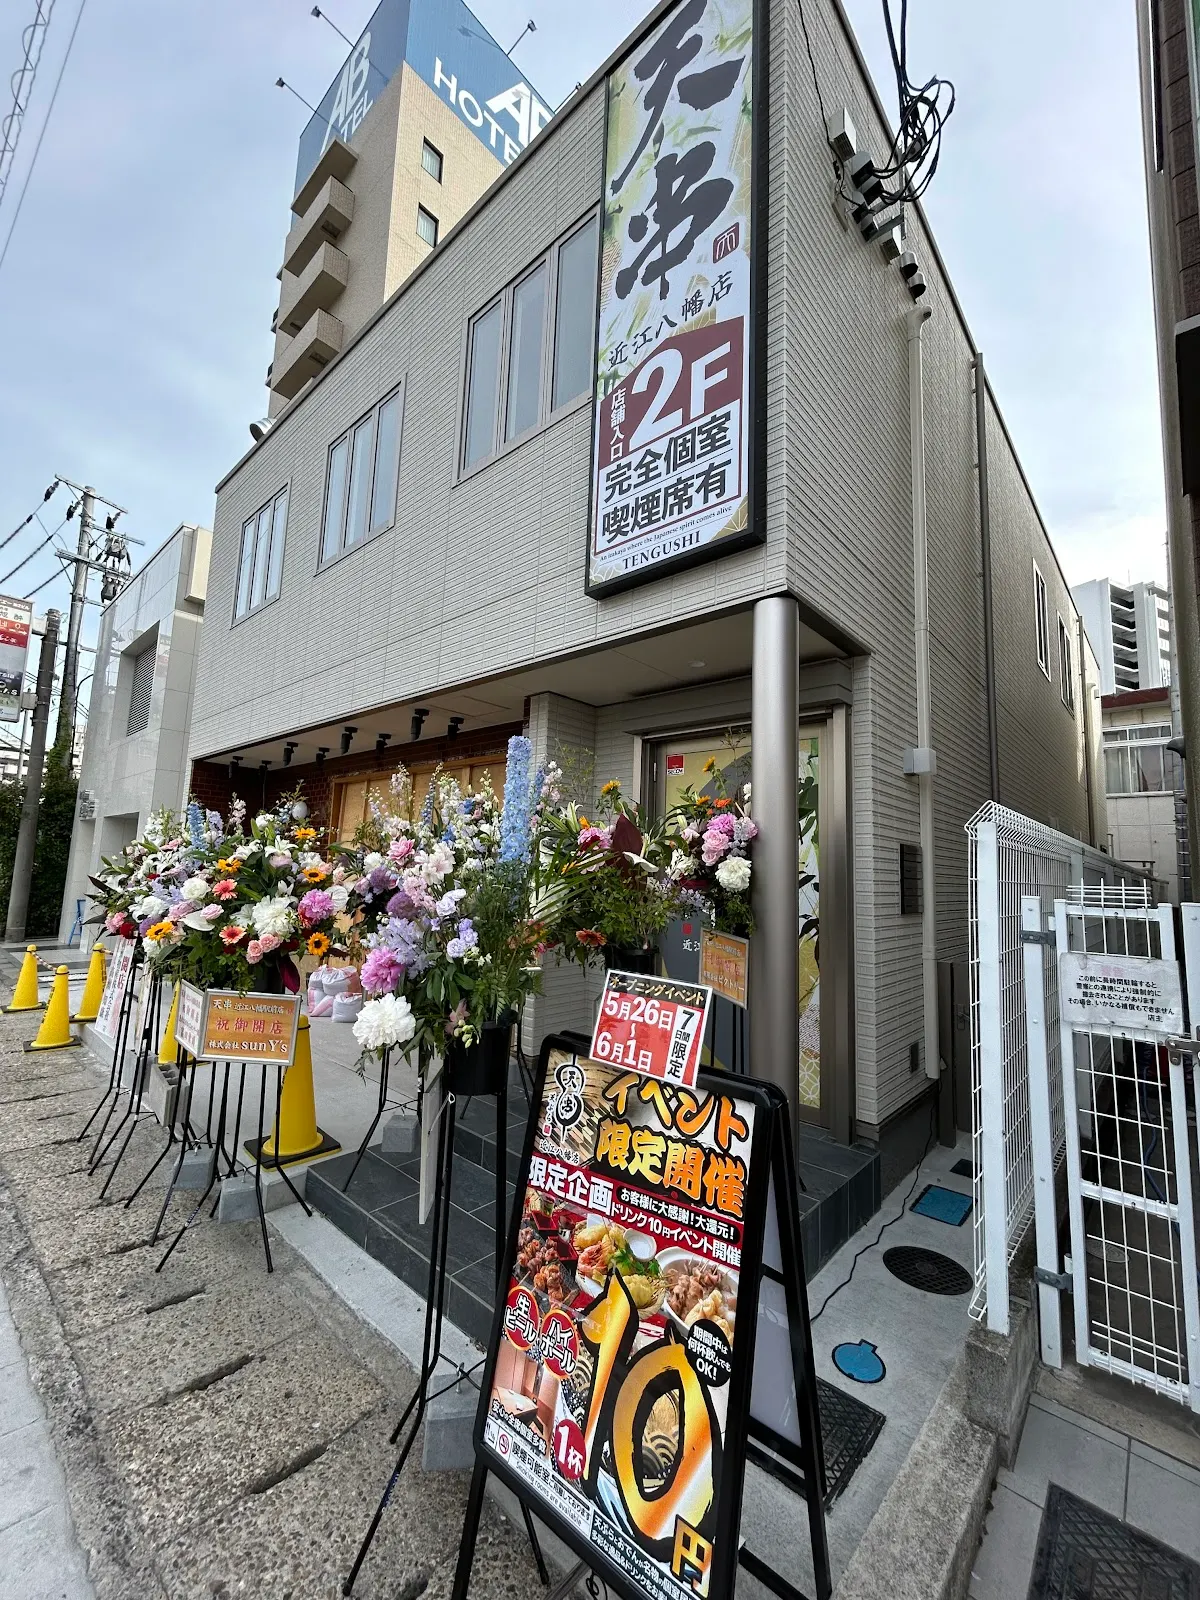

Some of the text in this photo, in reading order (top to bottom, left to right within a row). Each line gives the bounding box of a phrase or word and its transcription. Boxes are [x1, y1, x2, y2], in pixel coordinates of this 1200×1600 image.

[341, 90, 374, 144] TEL
[433, 56, 521, 166] HOTE
[608, 270, 734, 371] 近江八幡店
[628, 341, 732, 452] 2F
[609, 387, 627, 462] 店舗入口
[604, 410, 732, 503] 完全個室
[601, 459, 733, 544] 喫煙席有
[622, 530, 701, 570] TENGUSHI
[627, 540, 643, 551] where
[644, 537, 653, 545] the
[654, 527, 679, 541] Japanese
[679, 520, 696, 531] spirit
[696, 512, 716, 524] comes
[716, 505, 733, 517] alive
[213, 999, 232, 1010] 天串
[604, 992, 674, 1031] 5月26日
[609, 976, 704, 1006] オープニングイベント
[216, 1017, 284, 1035] 祝御開店
[1147, 1014, 1163, 1022] 店主
[208, 1040, 240, 1050] 株式会社
[596, 1032, 653, 1072] 6月1日
[604, 1073, 748, 1149] イベント
[528, 1155, 613, 1216] 限定企画
[596, 1119, 746, 1217] 限定開催
[611, 1202, 742, 1267] ドリンク10円イベント開催
[620, 1188, 734, 1240] お客様に大感謝！大還元！
[504, 1306, 538, 1344] ビール
[692, 1325, 729, 1355] 期間中は
[540, 1335, 577, 1374] ボール
[687, 1337, 732, 1373] 何杯飲んでも
[695, 1358, 718, 1381] OK！
[557, 1425, 584, 1475] 1杯
[516, 1461, 535, 1486] Smoking
[535, 1479, 550, 1497] rooms
[550, 1493, 559, 1505] are
[558, 1502, 582, 1526] available
